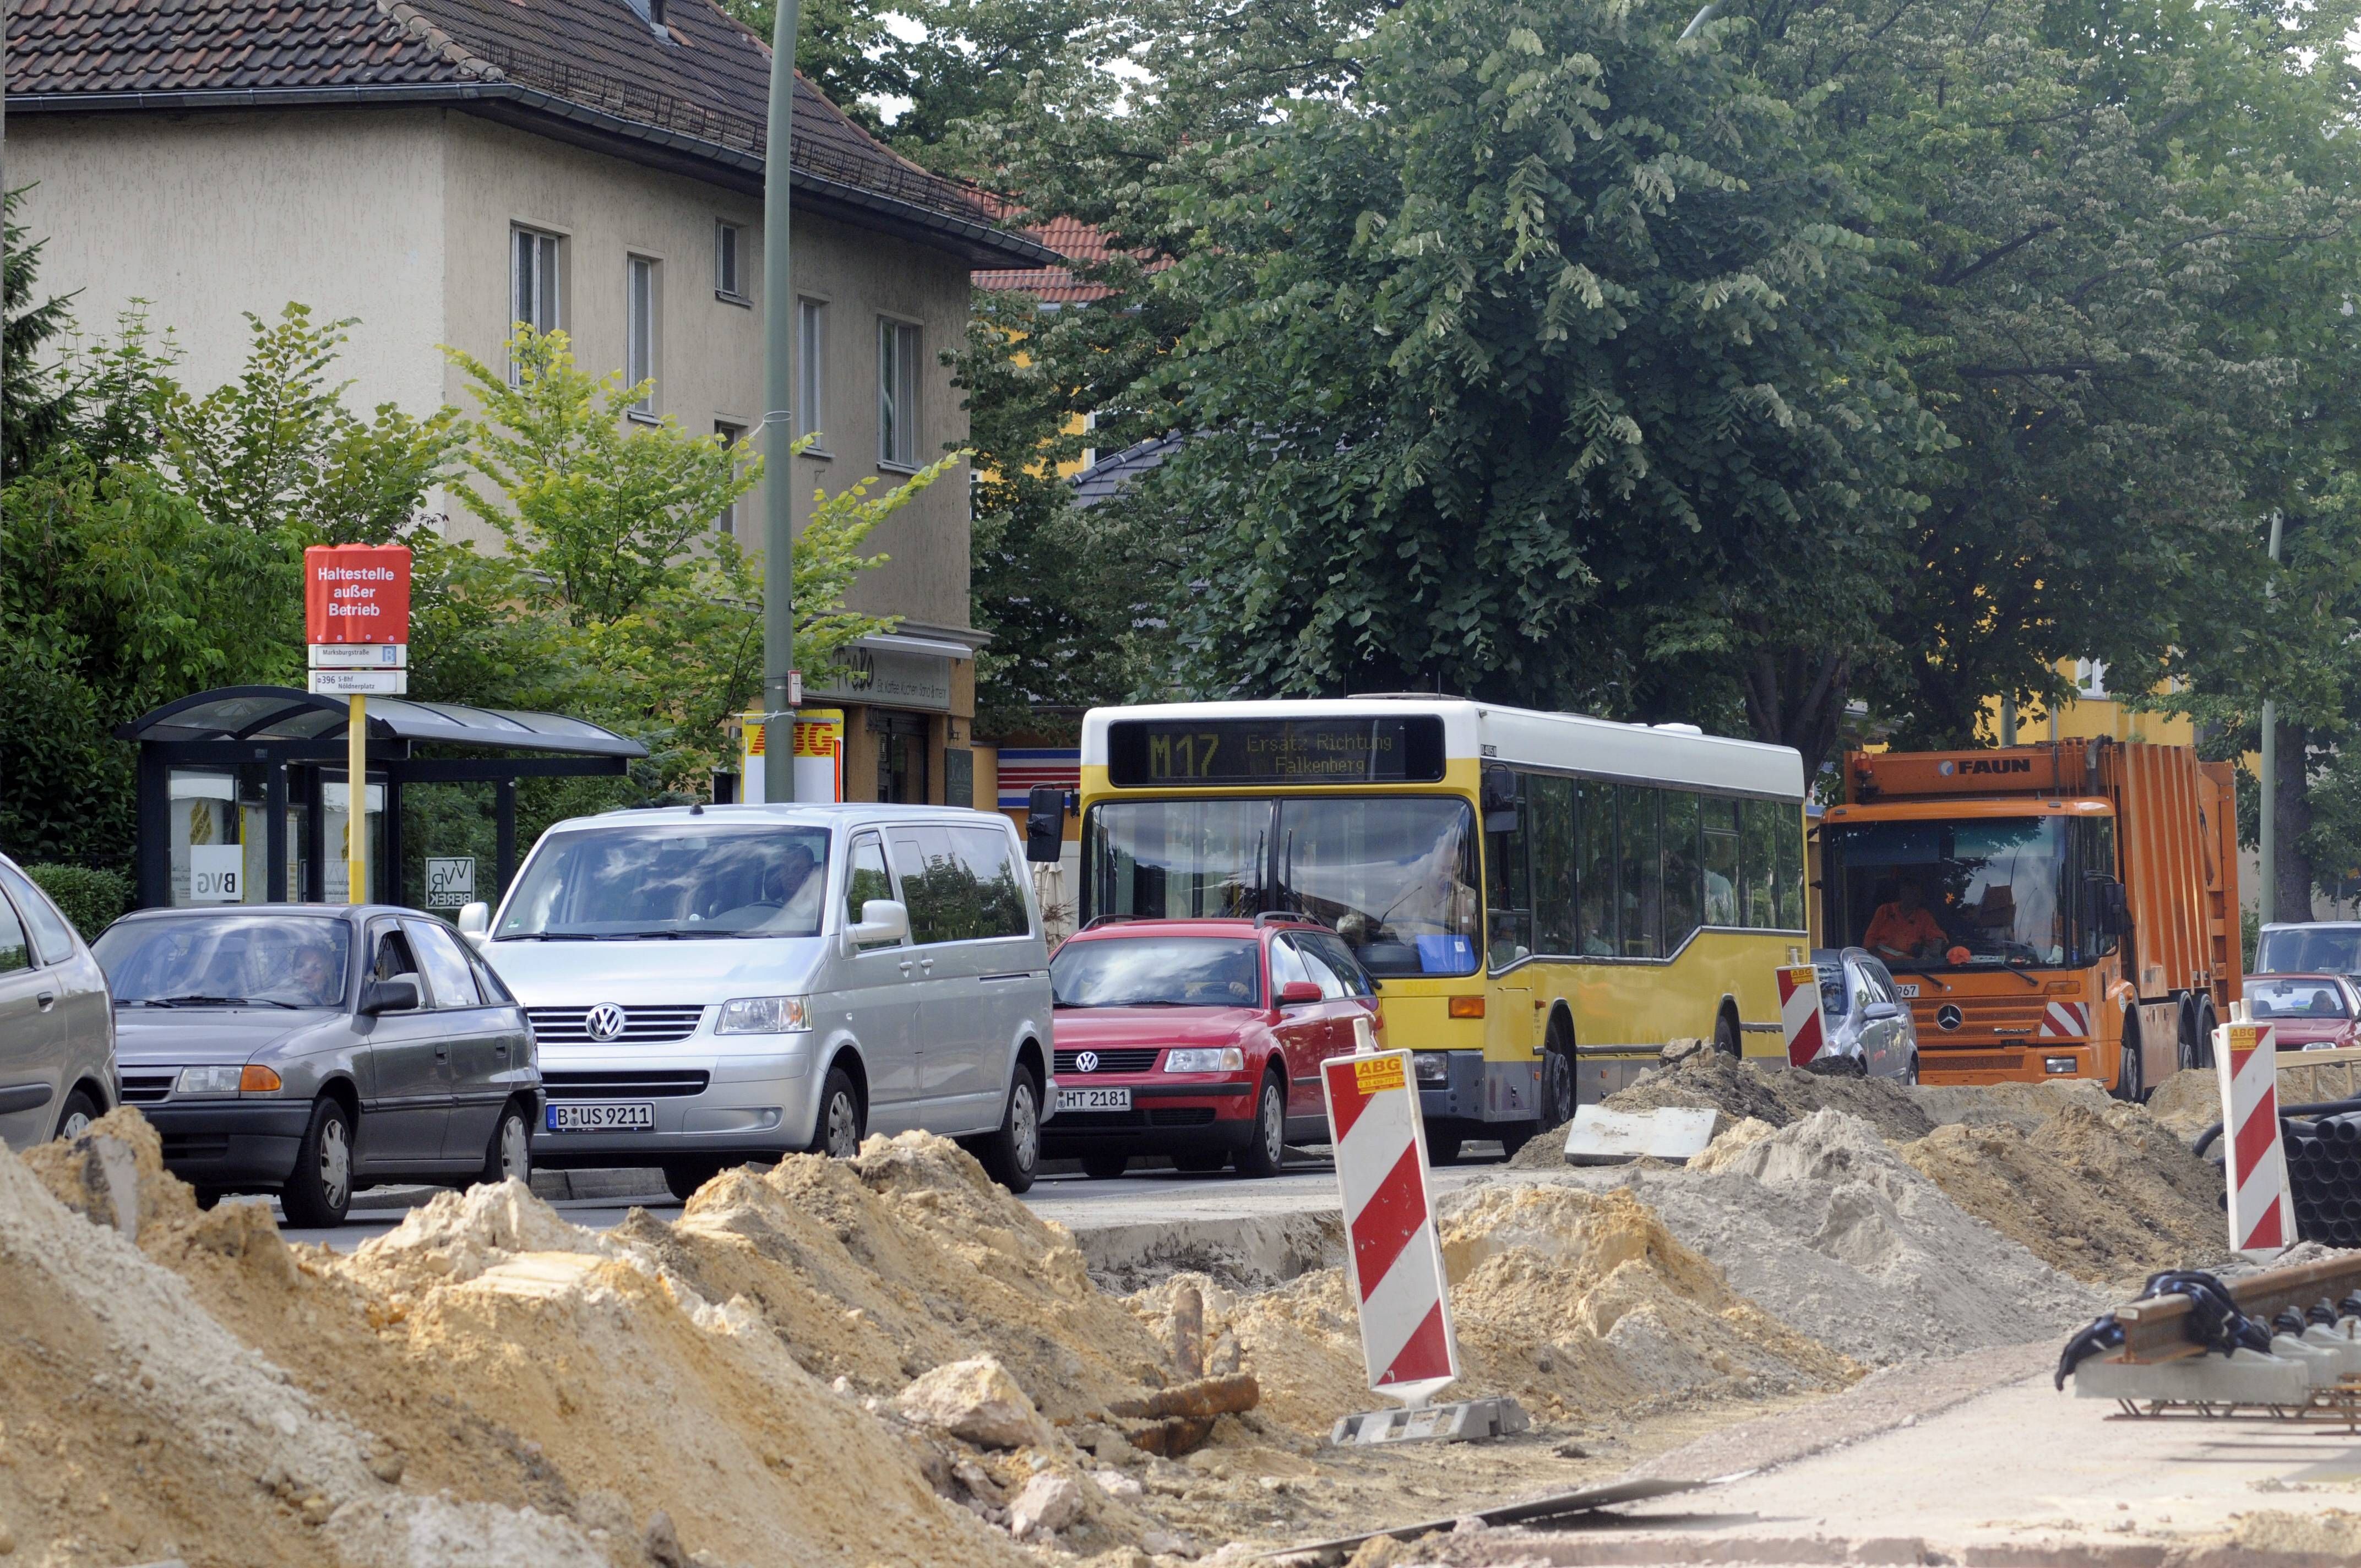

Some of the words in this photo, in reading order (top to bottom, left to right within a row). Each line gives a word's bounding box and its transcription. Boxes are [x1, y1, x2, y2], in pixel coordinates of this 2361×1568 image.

[318, 567, 395, 581] Haltestelle
[334, 585, 376, 598] außer
[329, 603, 380, 616] Betrieb
[323, 649, 370, 657] Marksburgstraße
[385, 649, 394, 661] B
[322, 676, 335, 684] 396
[1150, 733, 1220, 778] M17
[1247, 734, 1308, 752] Ersatz
[1316, 733, 1392, 751] Richtung
[1275, 756, 1365, 774] Falkenberg
[1959, 759, 2031, 775] FAUN
[1792, 968, 1811, 977] ABG
[2231, 1028, 2255, 1037] ABG
[1358, 1058, 1400, 1075] ABG
[1067, 1092, 1085, 1106] HT
[1090, 1091, 1128, 1106] 2181
[558, 1108, 568, 1125] B
[580, 1108, 602, 1125] US
[606, 1107, 649, 1125] 9211
